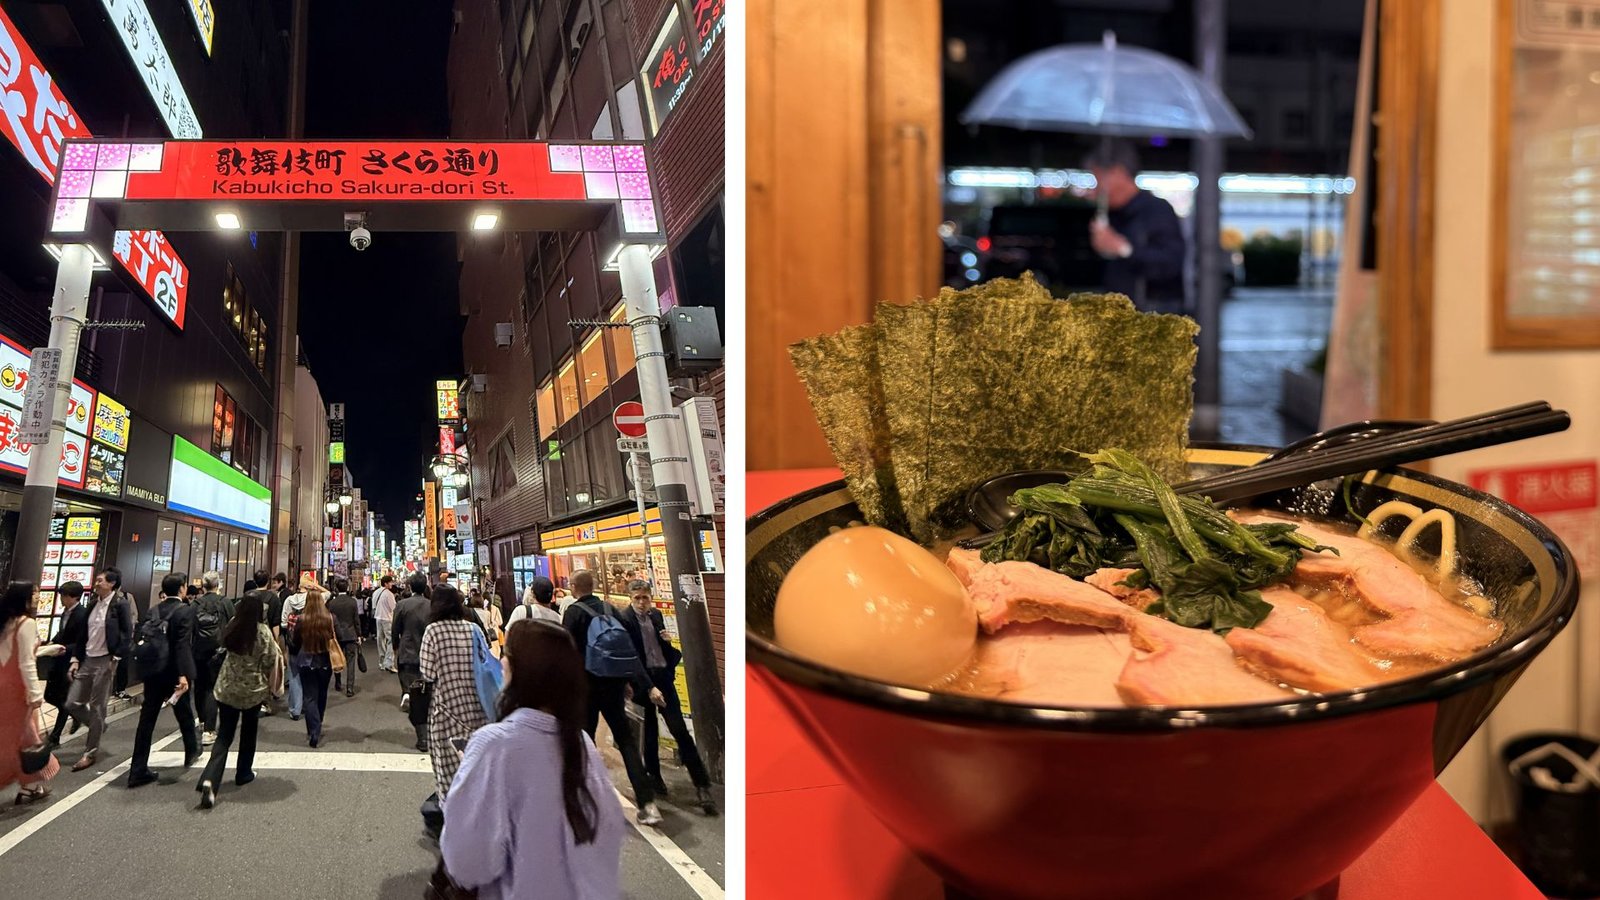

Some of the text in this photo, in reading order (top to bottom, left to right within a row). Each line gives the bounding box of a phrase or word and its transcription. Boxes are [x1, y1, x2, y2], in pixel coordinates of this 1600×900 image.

[215, 147, 500, 176] 歌舞伎町 さくら通り
[212, 179, 515, 195] Kabukicho Sakura-dori St.
[157, 277, 176, 313] 2F
[31, 350, 51, 430] 防犯カメラ作動中
[97, 403, 125, 432] 麻雀
[126, 484, 153, 501] IMAMIYA
